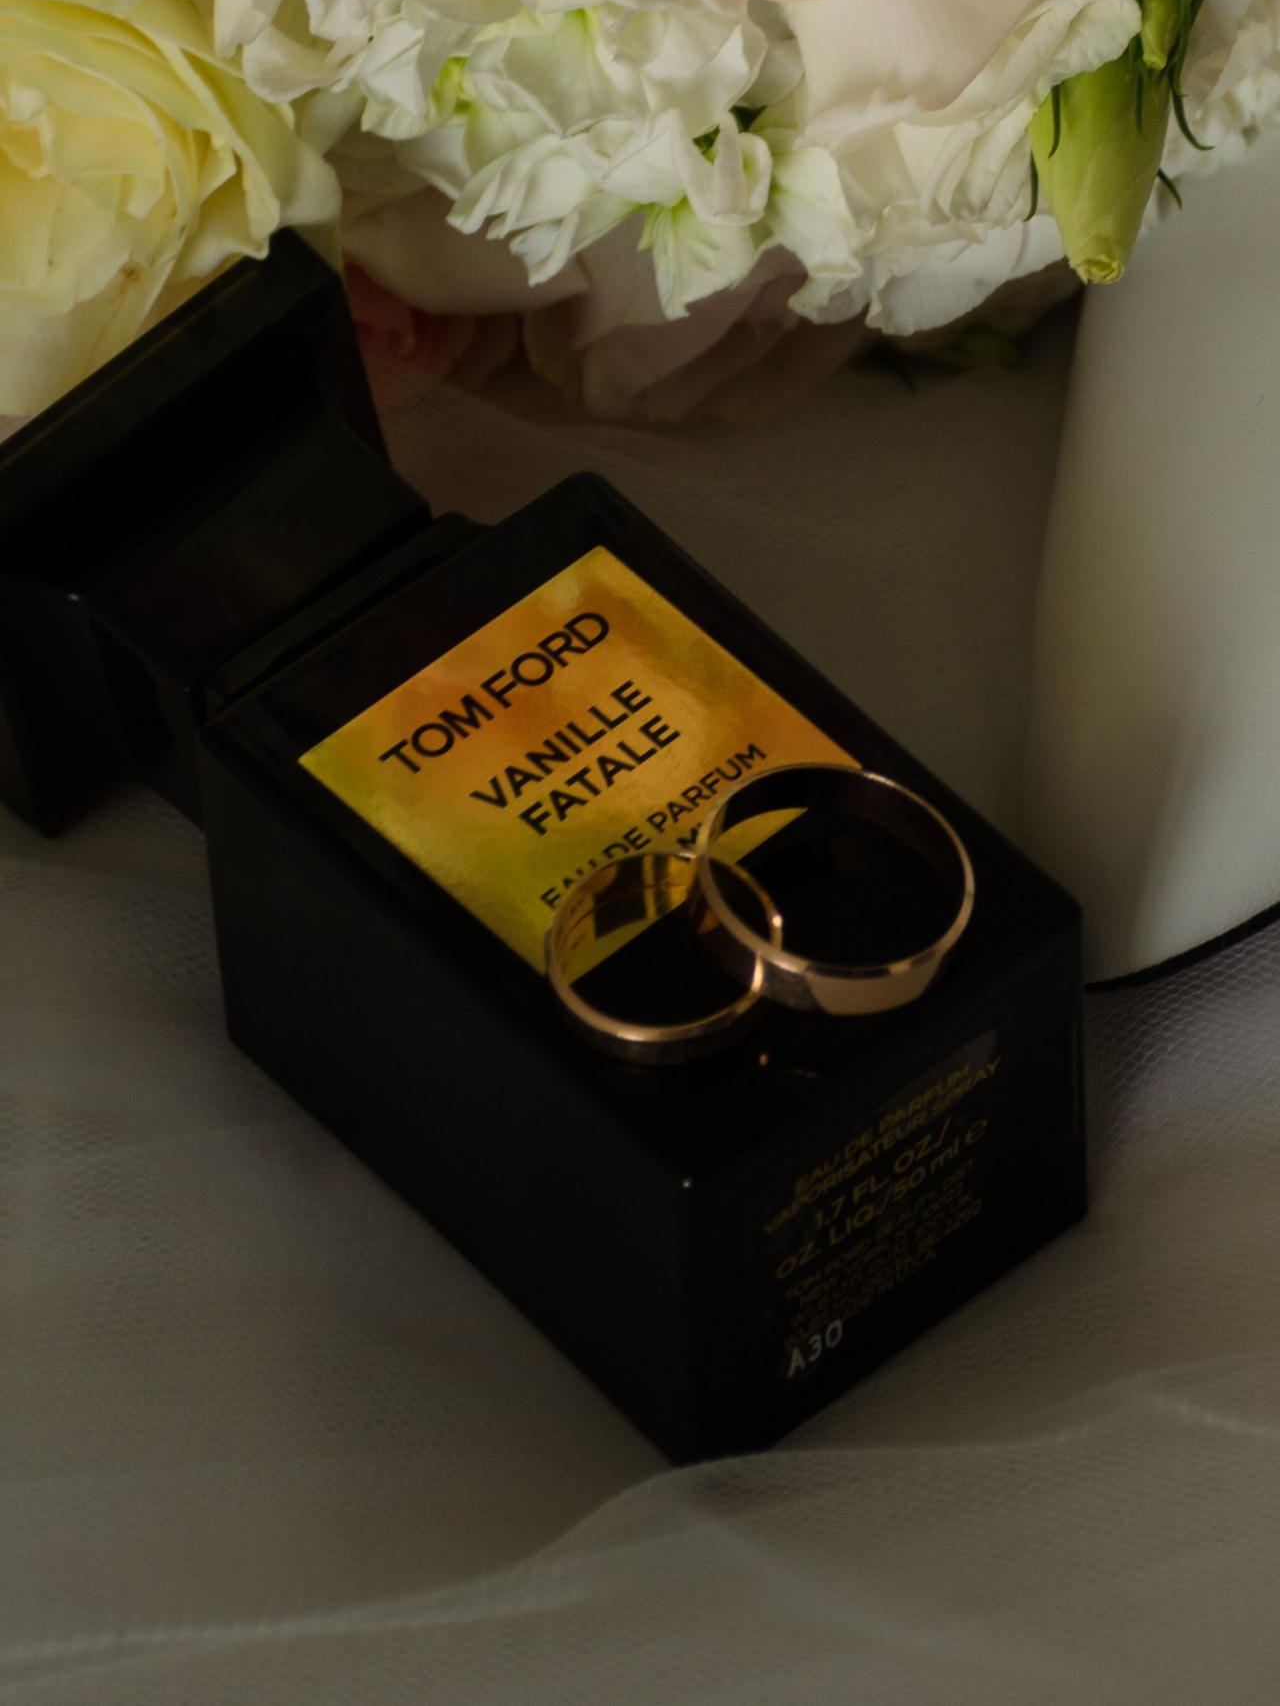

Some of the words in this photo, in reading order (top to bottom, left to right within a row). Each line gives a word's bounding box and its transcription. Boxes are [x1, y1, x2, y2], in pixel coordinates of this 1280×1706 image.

[378, 694, 495, 773] TOM
[481, 612, 610, 708] FORD
[469, 679, 652, 810] VANILLE
[519, 715, 680, 836] FATALE
[646, 743, 767, 833] PARFUM
[764, 1111, 928, 1234] VAPORISATEUR
[932, 1055, 1002, 1115] SPRAY
[795, 1153, 839, 1198] EAU
[845, 1129, 872, 1159] DE
[880, 1062, 971, 1139] PARFUM
[786, 1270, 821, 1300] TOM
[824, 1237, 872, 1275] FORD
[800, 1266, 839, 1306] NEW
[893, 1213, 917, 1238] NY
[921, 1177, 963, 1219] 10022
[814, 1195, 845, 1230] 1.7
[786, 1316, 844, 1379] A30
[838, 1287, 872, 1321] ADE
[876, 1272, 893, 1292] IN
